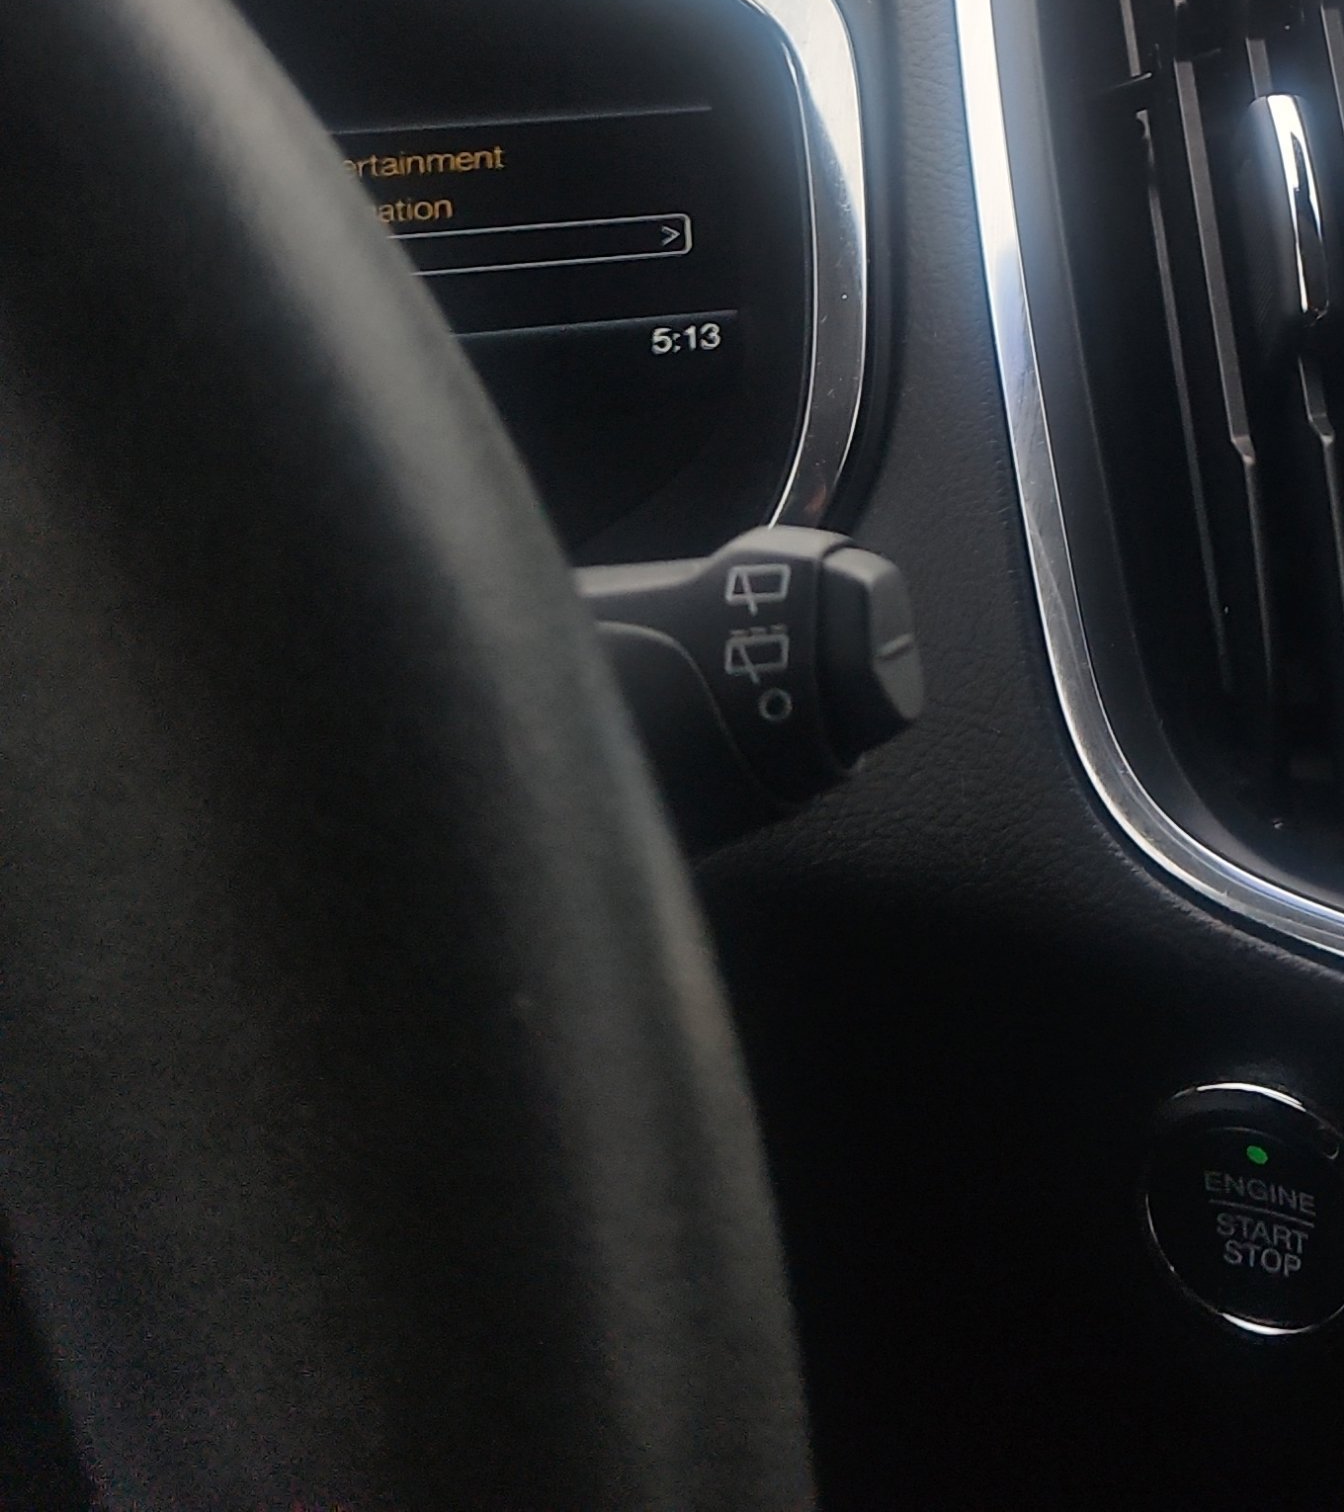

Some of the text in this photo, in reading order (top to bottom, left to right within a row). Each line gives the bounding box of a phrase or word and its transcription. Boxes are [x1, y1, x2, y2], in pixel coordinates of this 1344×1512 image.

[650, 323, 722, 356] 5:13
[1204, 1170, 1316, 1217] ENGINE
[1216, 1212, 1309, 1254] START
[1223, 1239, 1302, 1277] STOP
